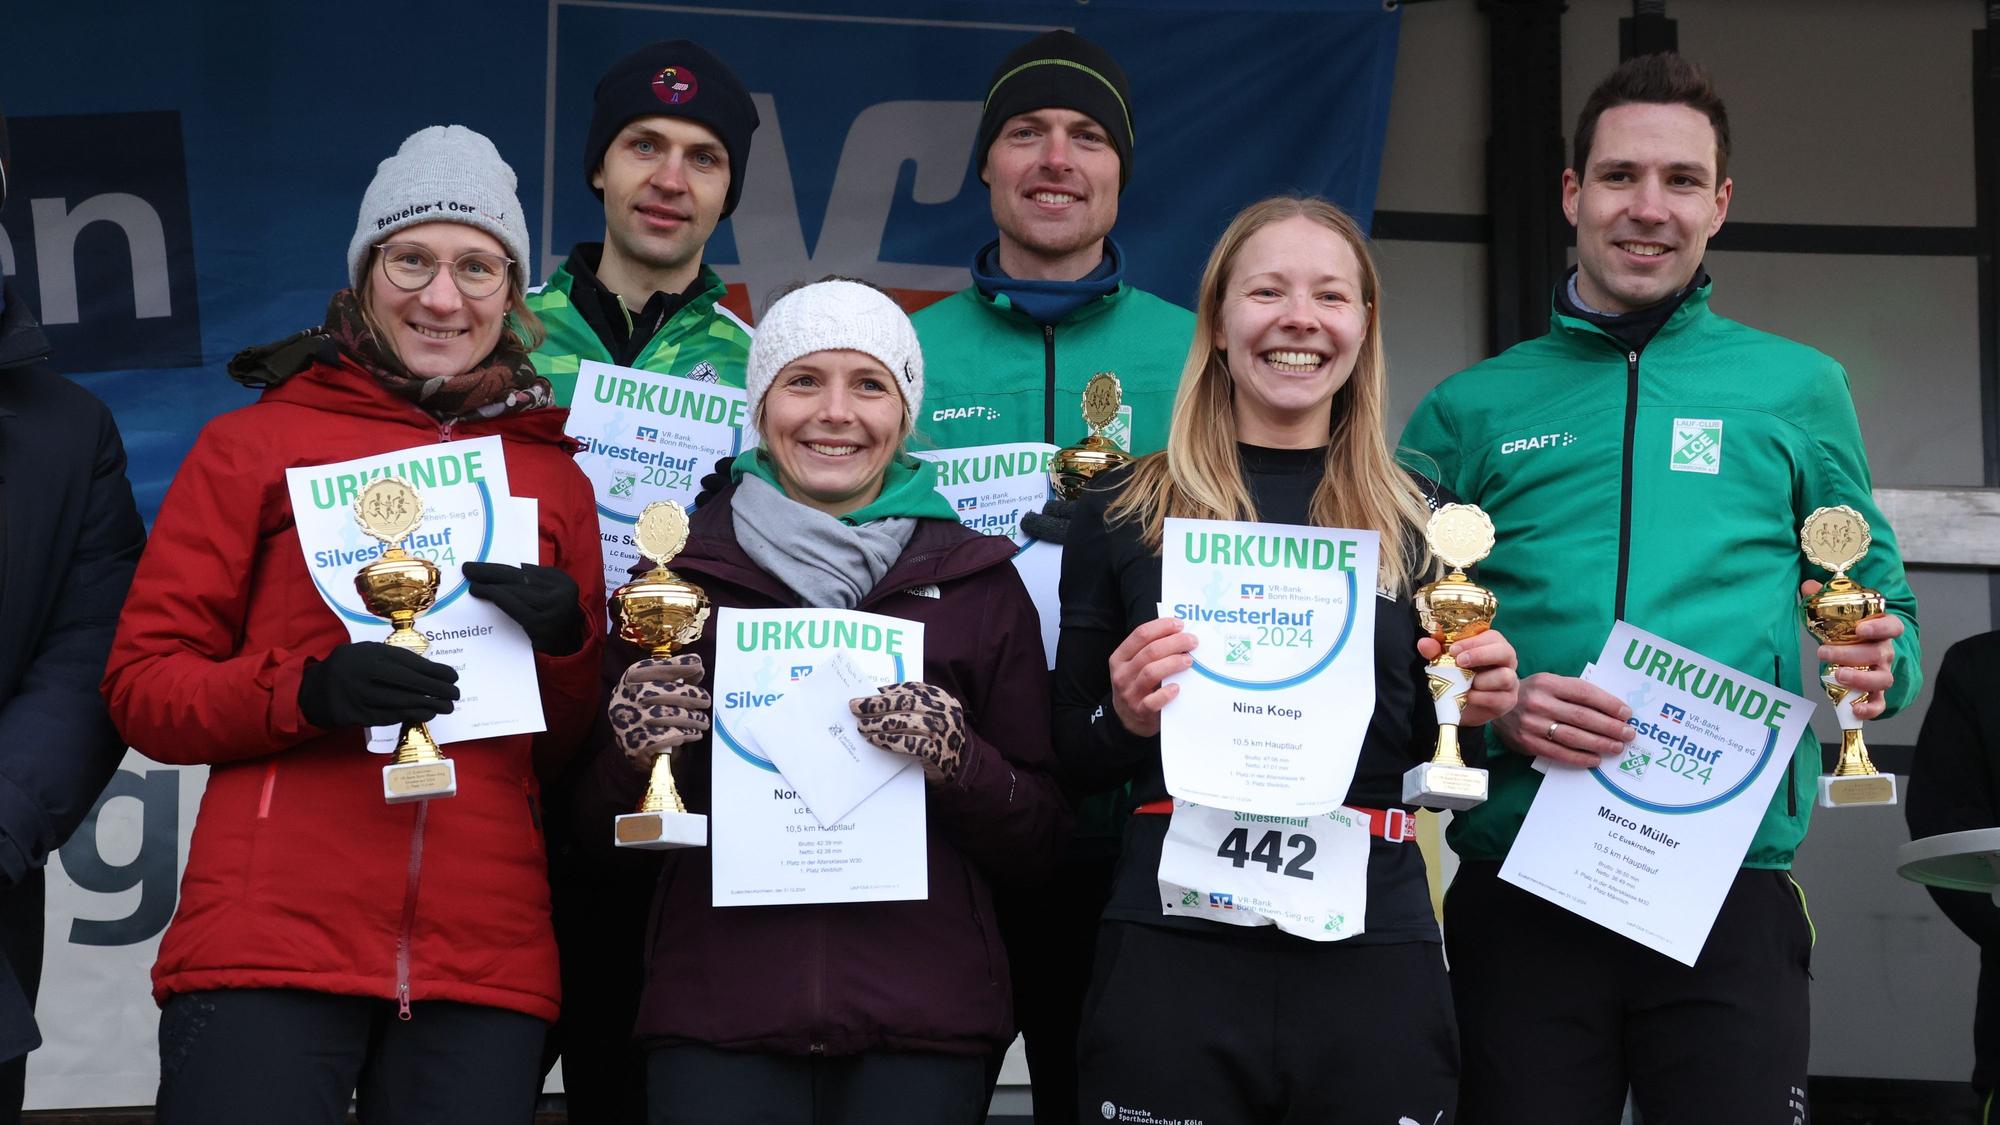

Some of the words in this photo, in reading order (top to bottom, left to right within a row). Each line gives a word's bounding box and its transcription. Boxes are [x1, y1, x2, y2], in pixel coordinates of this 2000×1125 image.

[377, 204, 431, 230] Beueler
[0, 193, 172, 325] n
[594, 374, 748, 429] URKUNDE
[932, 406, 985, 422] CRAFT
[661, 431, 691, 441] VR-Bank
[1501, 434, 1561, 454] CRAFT
[660, 438, 678, 446] Bonn
[678, 441, 714, 454] Rhein-Sieg
[640, 466, 692, 491] 2024
[981, 492, 1008, 500] VR-Bank
[997, 495, 1032, 505] Rhein-Sieg
[315, 528, 452, 568] Silvestrlauf
[1185, 532, 1358, 573] URKUNDE
[614, 565, 625, 573] km
[1268, 585, 1301, 593] VR-Bank
[1289, 594, 1330, 604] Rhein-Sieg
[1174, 603, 1314, 627] Silvesterlauf
[425, 625, 494, 642] Schneider
[736, 620, 904, 656] URKUNDE
[1256, 626, 1314, 648] 2024
[435, 647, 464, 656] Altenahr
[1623, 638, 1791, 731] URKUNDE
[1233, 701, 1263, 714] Nina
[1267, 704, 1302, 720] Koep
[1689, 713, 1721, 732] VR-Bank
[1685, 721, 1703, 733] Bonn
[1704, 728, 1743, 750] Rhein-Sieg
[1655, 747, 1713, 785] 2024
[794, 807, 804, 815] LC
[786, 825, 802, 833] 10,5
[1597, 806, 1637, 831] Marco
[1639, 824, 1680, 849] Müller
[1608, 830, 1619, 839] LC
[1619, 835, 1656, 856] Euskirchen
[1217, 827, 1317, 880] 442
[1609, 848, 1622, 859] km
[1622, 855, 1659, 875] Hauptlauf
[1237, 896, 1272, 907] VR-Bank
[1119, 1106, 1151, 1117] Deutsche
[1119, 1113, 1181, 1125] Sporthochschule
